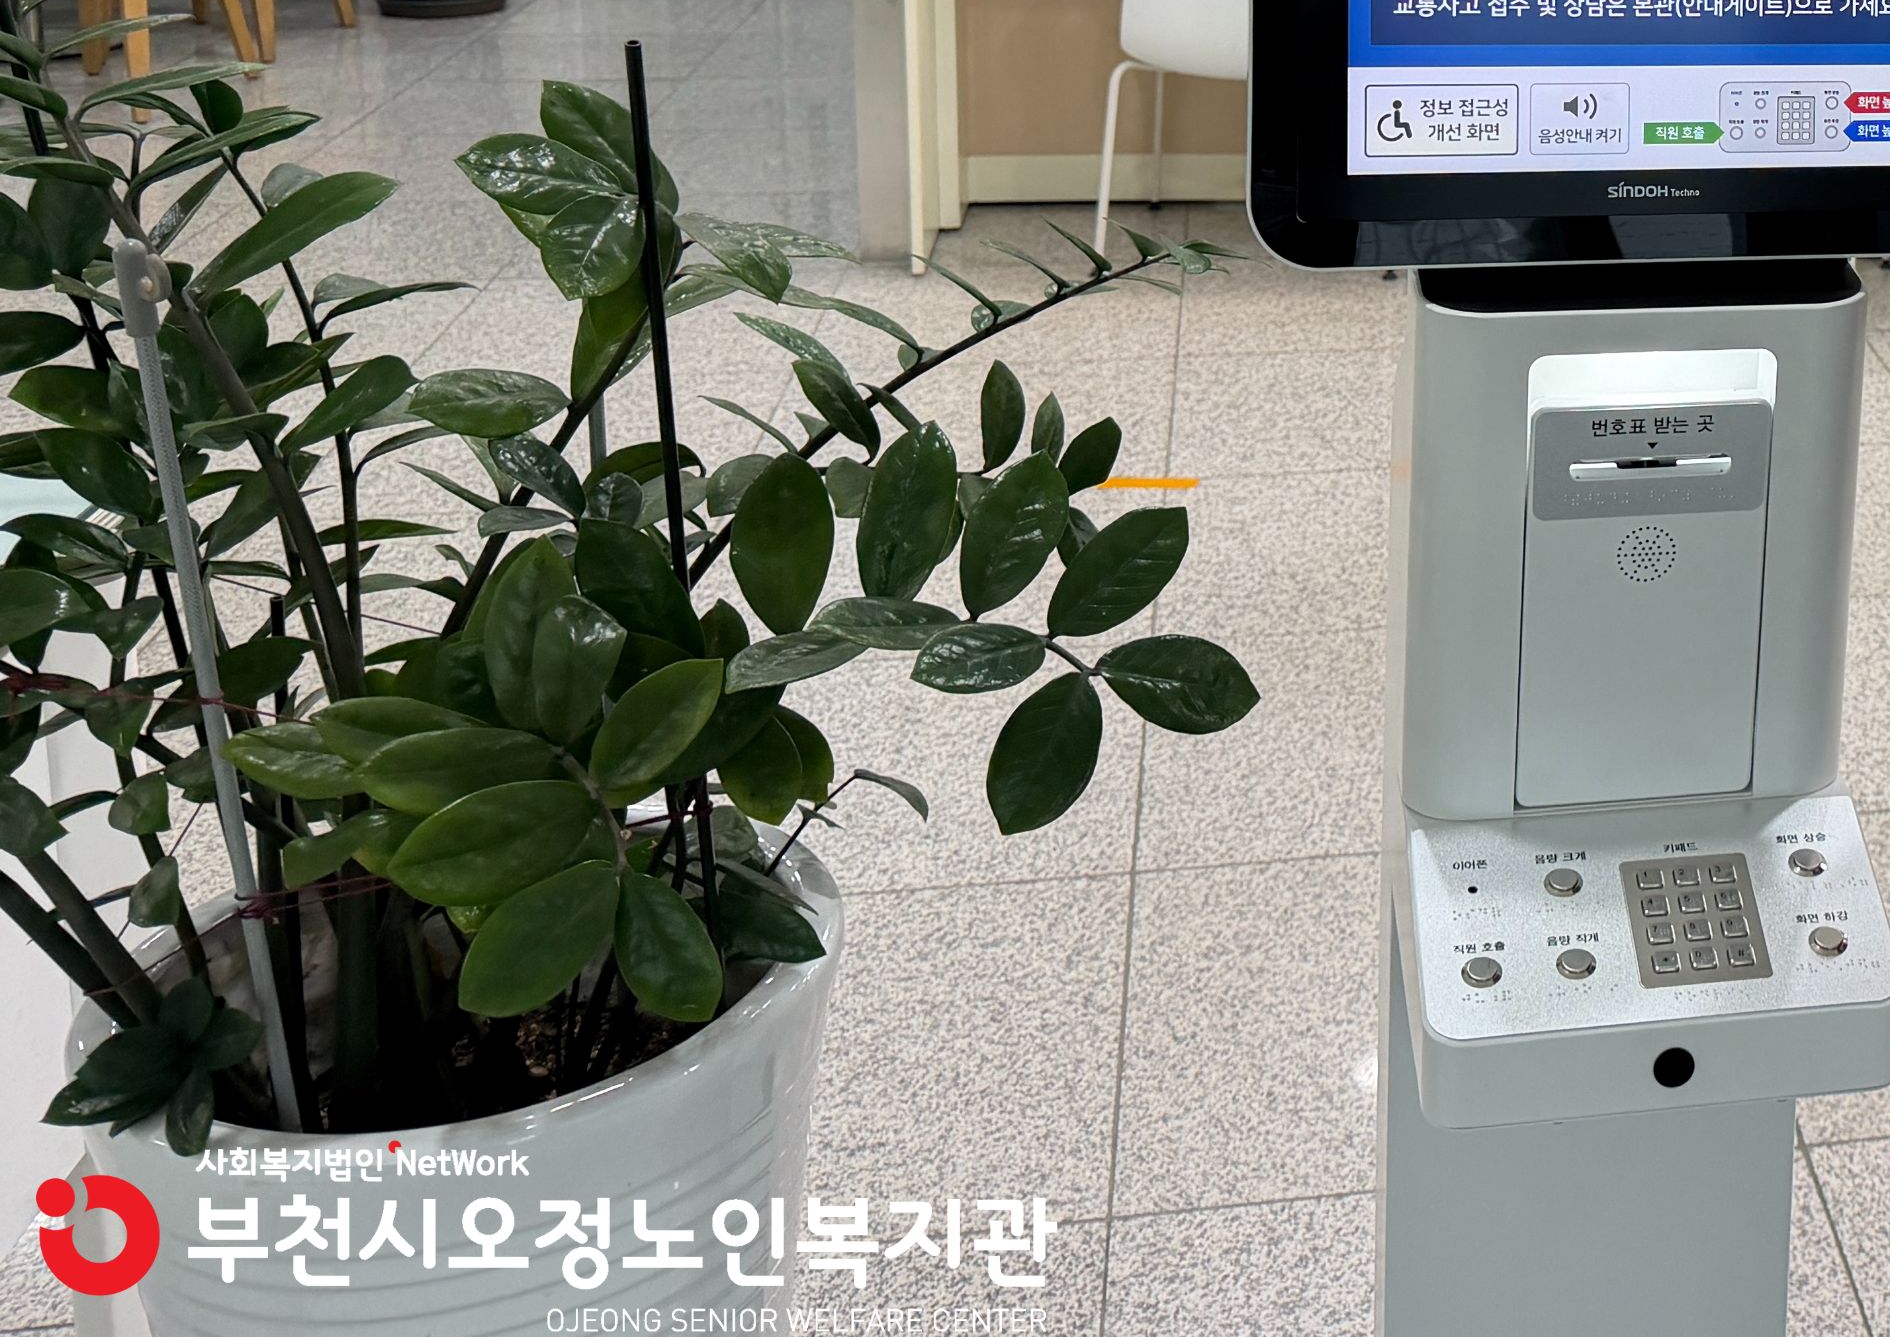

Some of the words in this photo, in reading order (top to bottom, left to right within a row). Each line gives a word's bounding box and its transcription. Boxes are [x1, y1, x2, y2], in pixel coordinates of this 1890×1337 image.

[1419, 99, 1453, 118] 정보
[1459, 98, 1509, 118] 접근성
[1857, 96, 1880, 109] 화면
[1428, 124, 1461, 142] 개선
[1466, 122, 1500, 142] 화면
[1538, 127, 1591, 145] 음성안내
[1595, 127, 1622, 144] 켜기
[1655, 126, 1679, 141] 직원
[1682, 126, 1704, 141] 호출
[1670, 189, 1699, 197] Techno
[1592, 418, 1646, 437] 번호표
[1654, 416, 1688, 434] 받는
[1697, 415, 1714, 432] 곳
[1453, 860, 1487, 870] 이어폰
